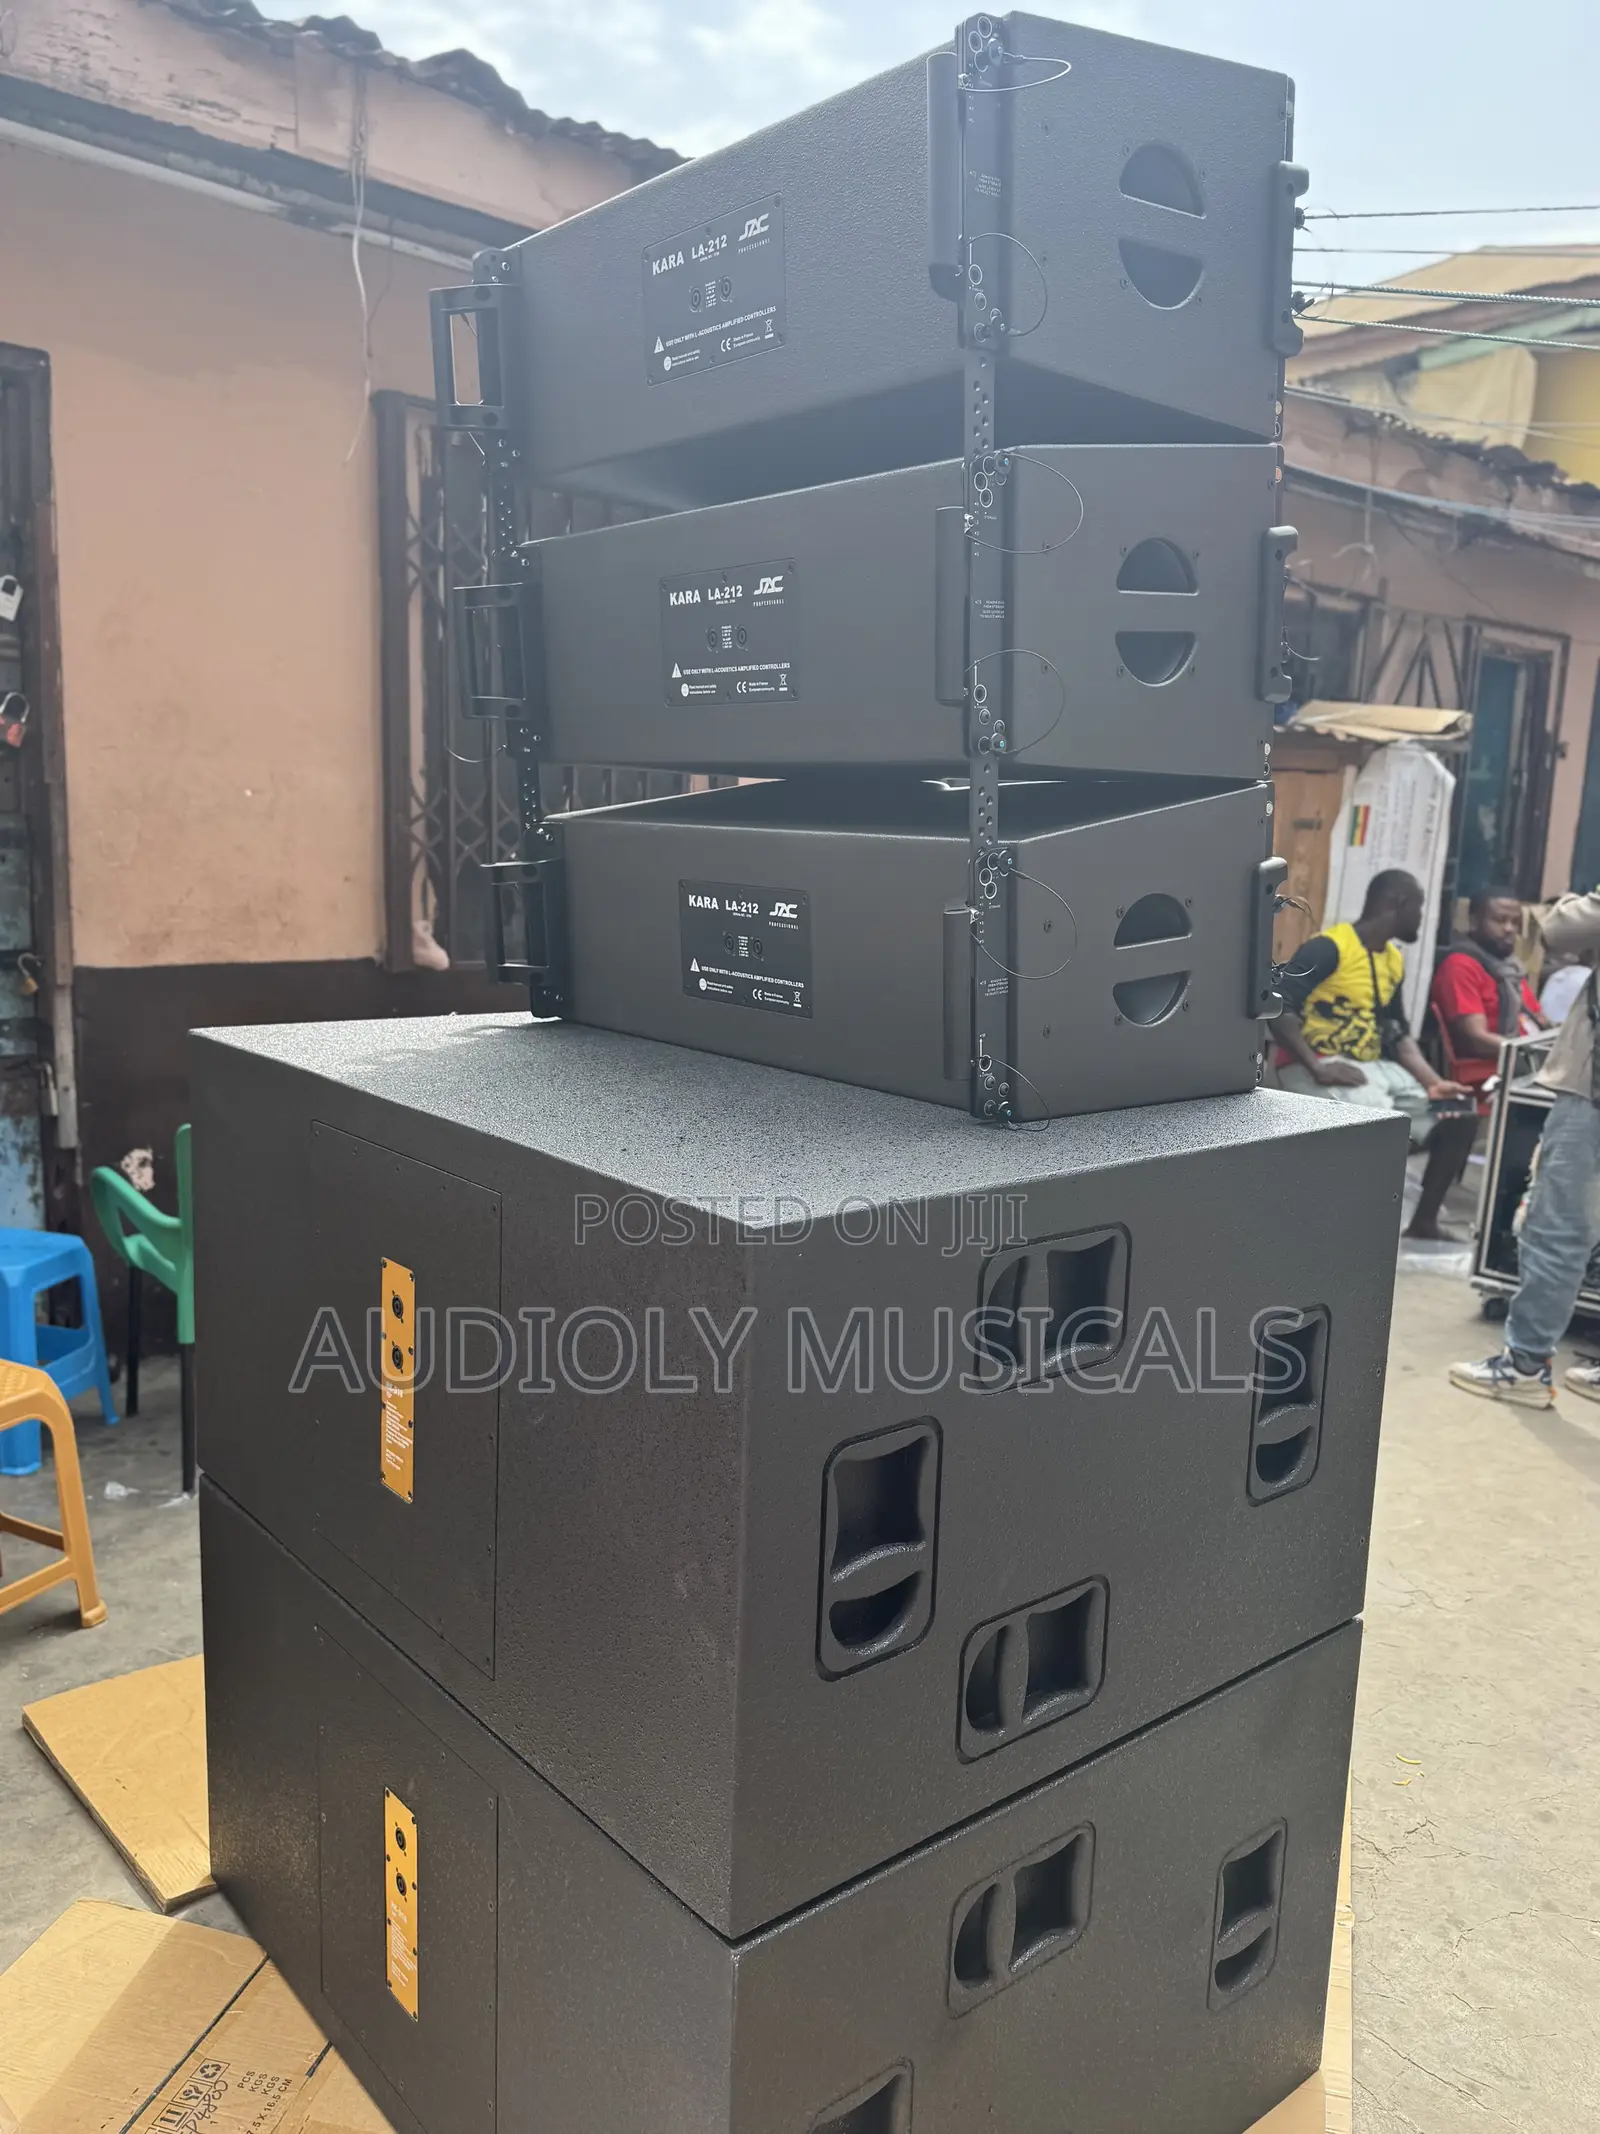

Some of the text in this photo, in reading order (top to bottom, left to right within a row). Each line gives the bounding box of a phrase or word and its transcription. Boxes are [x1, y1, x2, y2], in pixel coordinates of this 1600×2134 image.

[652, 251, 684, 275] KARA
[692, 234, 727, 259] LA-212
[745, 306, 776, 322] CONTROLLERS
[670, 589, 701, 606] KARA
[708, 585, 743, 600] LA-212
[760, 662, 790, 670] CONTROLLERS
[688, 894, 759, 914] KARA LA-212
[774, 978, 804, 988] CONTROLLERS
[237, 2070, 255, 2088] PCS
[249, 2073, 267, 2092] KGS
[261, 2076, 280, 2095] KGS
[264, 2094, 281, 2111] 16.5
[278, 2078, 292, 2092] CM
